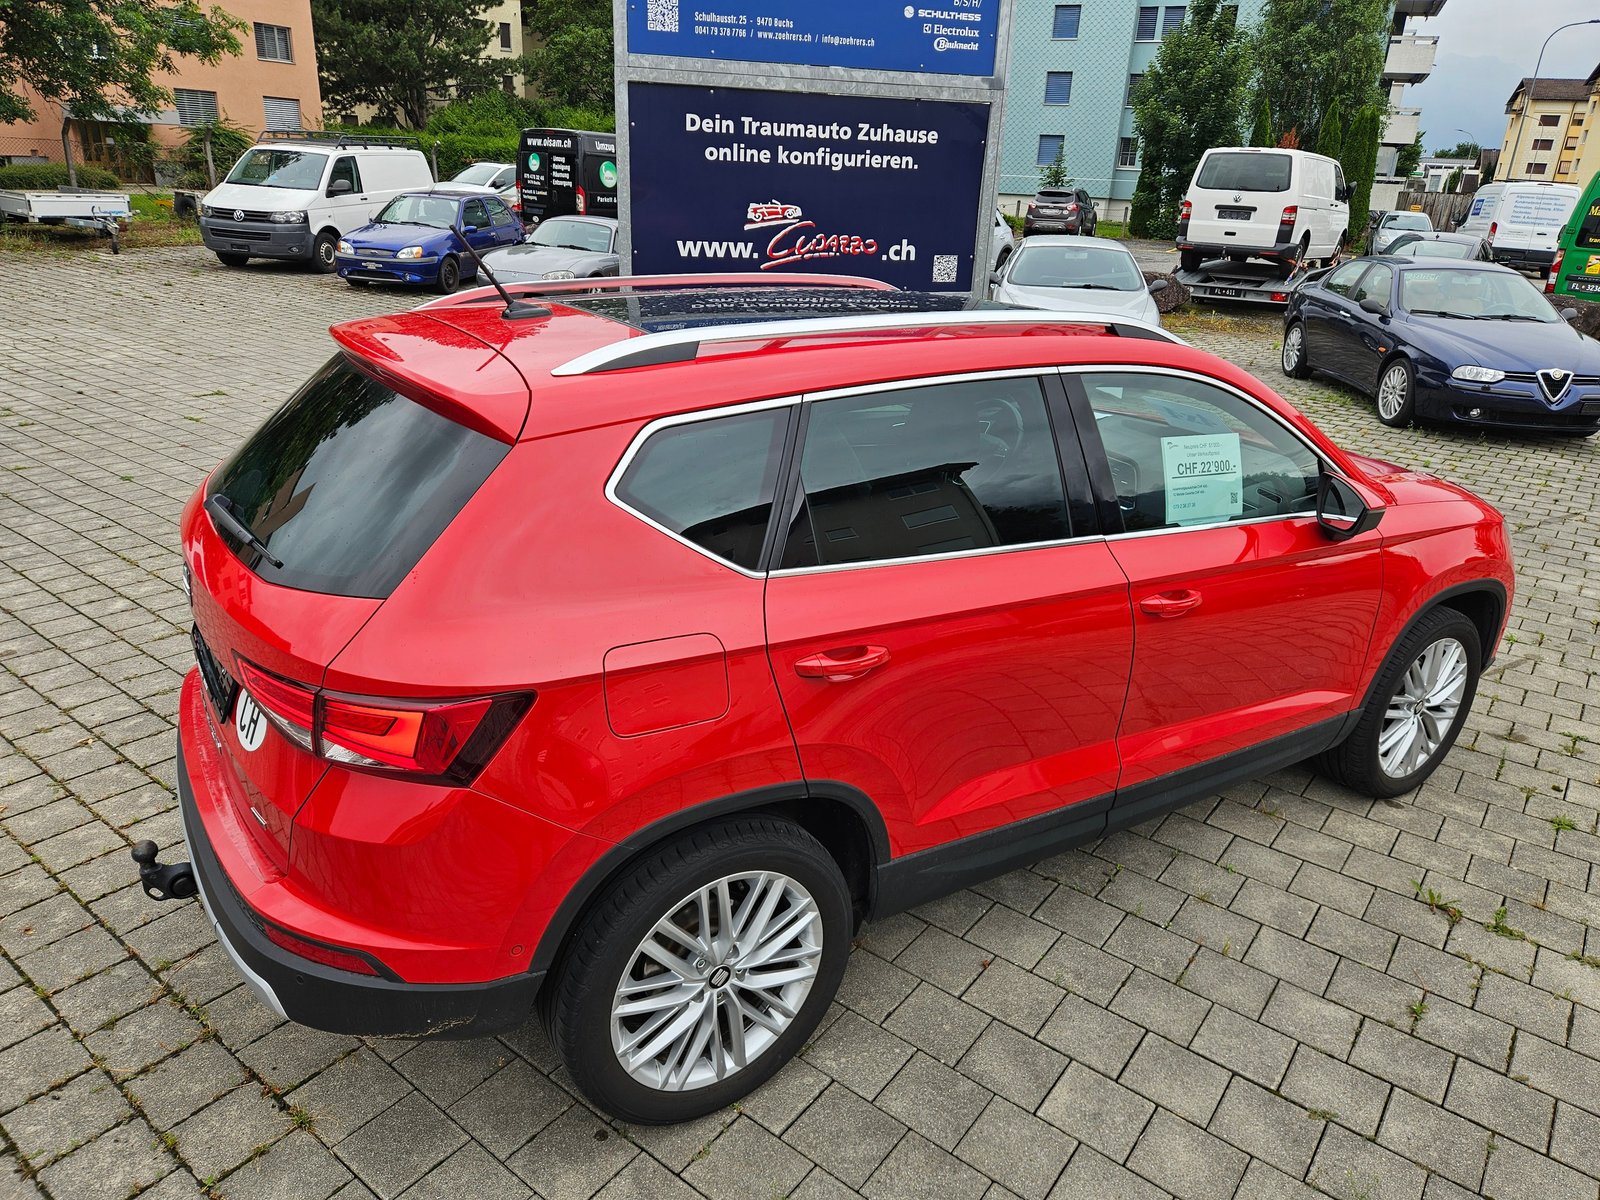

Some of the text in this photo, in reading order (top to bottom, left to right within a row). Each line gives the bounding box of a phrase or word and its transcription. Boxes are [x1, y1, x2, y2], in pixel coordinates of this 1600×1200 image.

[694, 11, 738, 24] Schulhausstr.
[738, 15, 747, 25] 25
[756, 16, 773, 27] 9470
[774, 18, 794, 28] Buchs
[918, 9, 982, 21] SCHULTHESS
[694, 25, 709, 35] 0041
[710, 26, 718, 36] 79
[719, 27, 731, 37] 378
[731, 28, 747, 38] 7766
[757, 31, 812, 42] www.zoehrers.ch
[821, 34, 875, 47] info@zoehrers.ch
[933, 24, 980, 38] Electrolux
[685, 113, 939, 145] Dein Traumauto Zuhause
[704, 143, 919, 171] online konfigurieren.
[676, 240, 759, 259] www.
[881, 239, 916, 261] .ch
[1571, 282, 1580, 290] FL
[1177, 459, 1237, 476] CHF.22'900.-
[239, 693, 261, 746] CH
